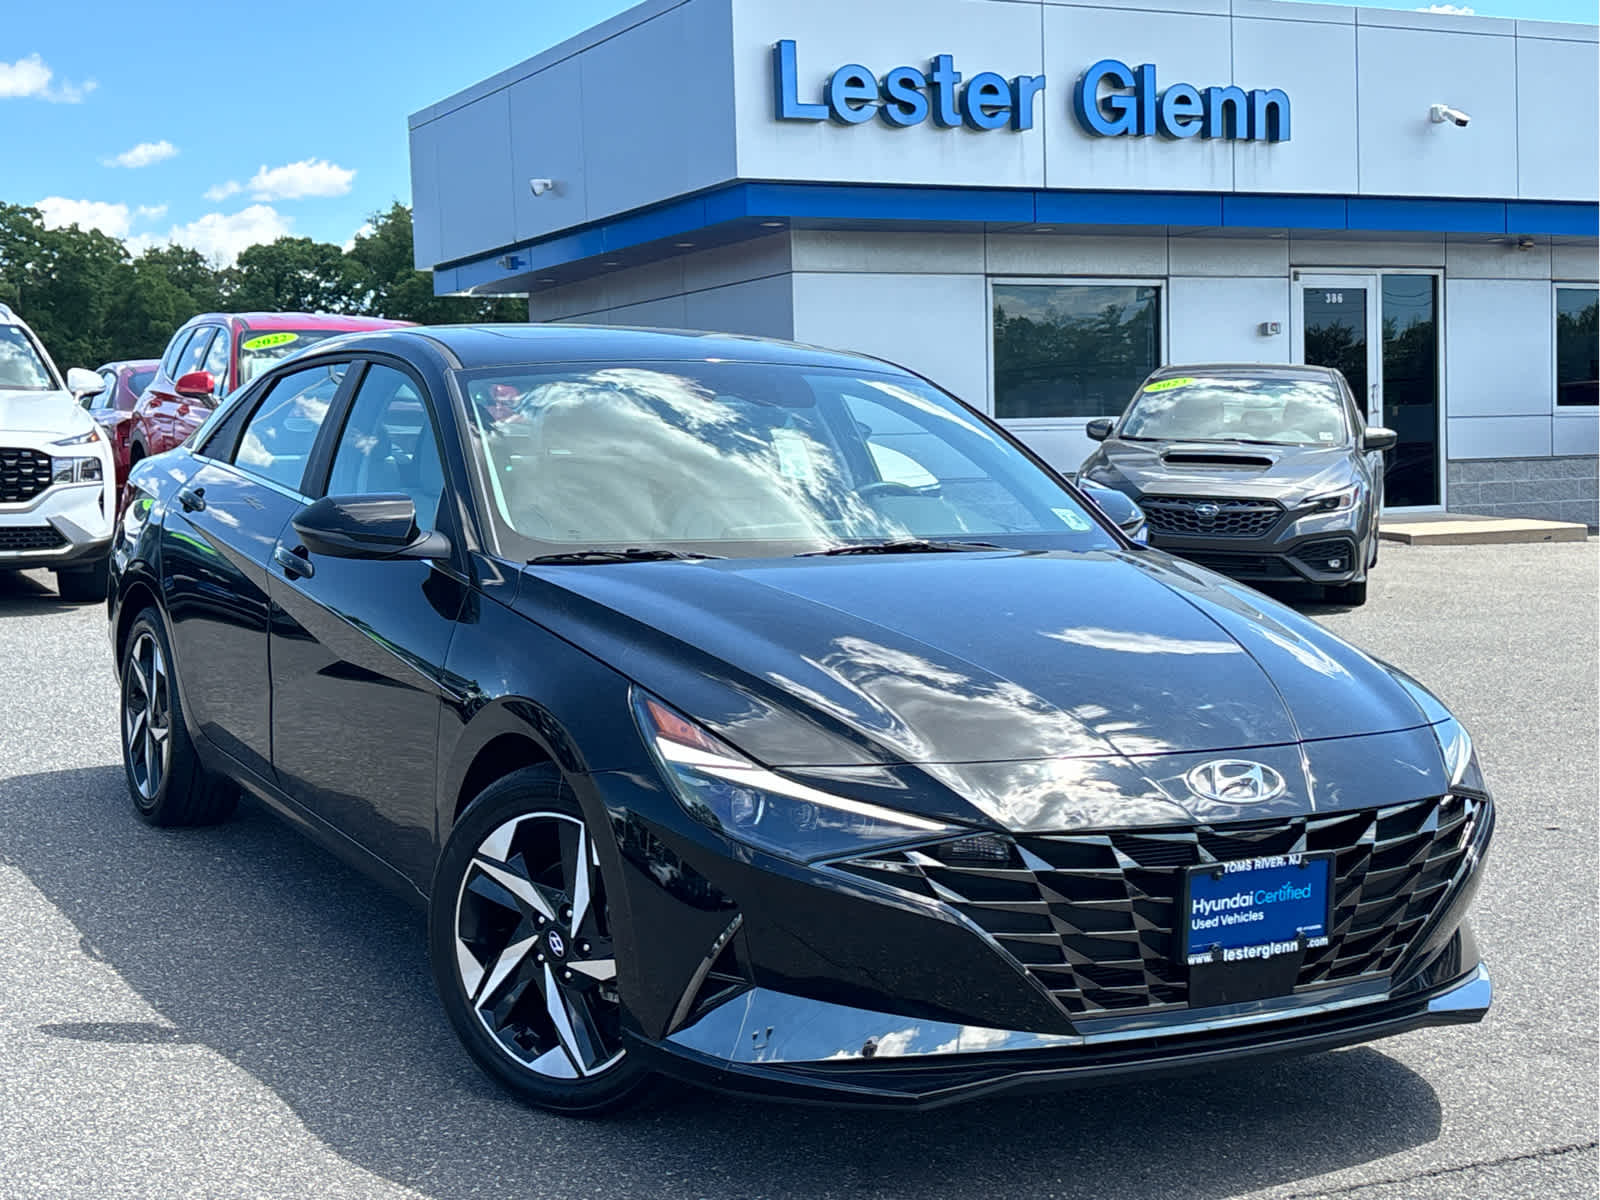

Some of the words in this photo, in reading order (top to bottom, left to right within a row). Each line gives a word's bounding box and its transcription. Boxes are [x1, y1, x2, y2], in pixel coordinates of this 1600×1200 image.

[772, 39, 1045, 132] Lester
[1074, 59, 1292, 142] Glenn
[1325, 293, 1343, 303] 386
[1223, 861, 1252, 874] TOMS
[1288, 854, 1302, 865] NJ
[1192, 891, 1254, 916] Hyundai
[1254, 882, 1312, 905] Certified
[1191, 915, 1219, 931] Used
[1220, 910, 1265, 927] Vehicles
[1187, 953, 1214, 966] www.
[1223, 940, 1299, 962] lesterglenn
[1306, 936, 1329, 948] .com
